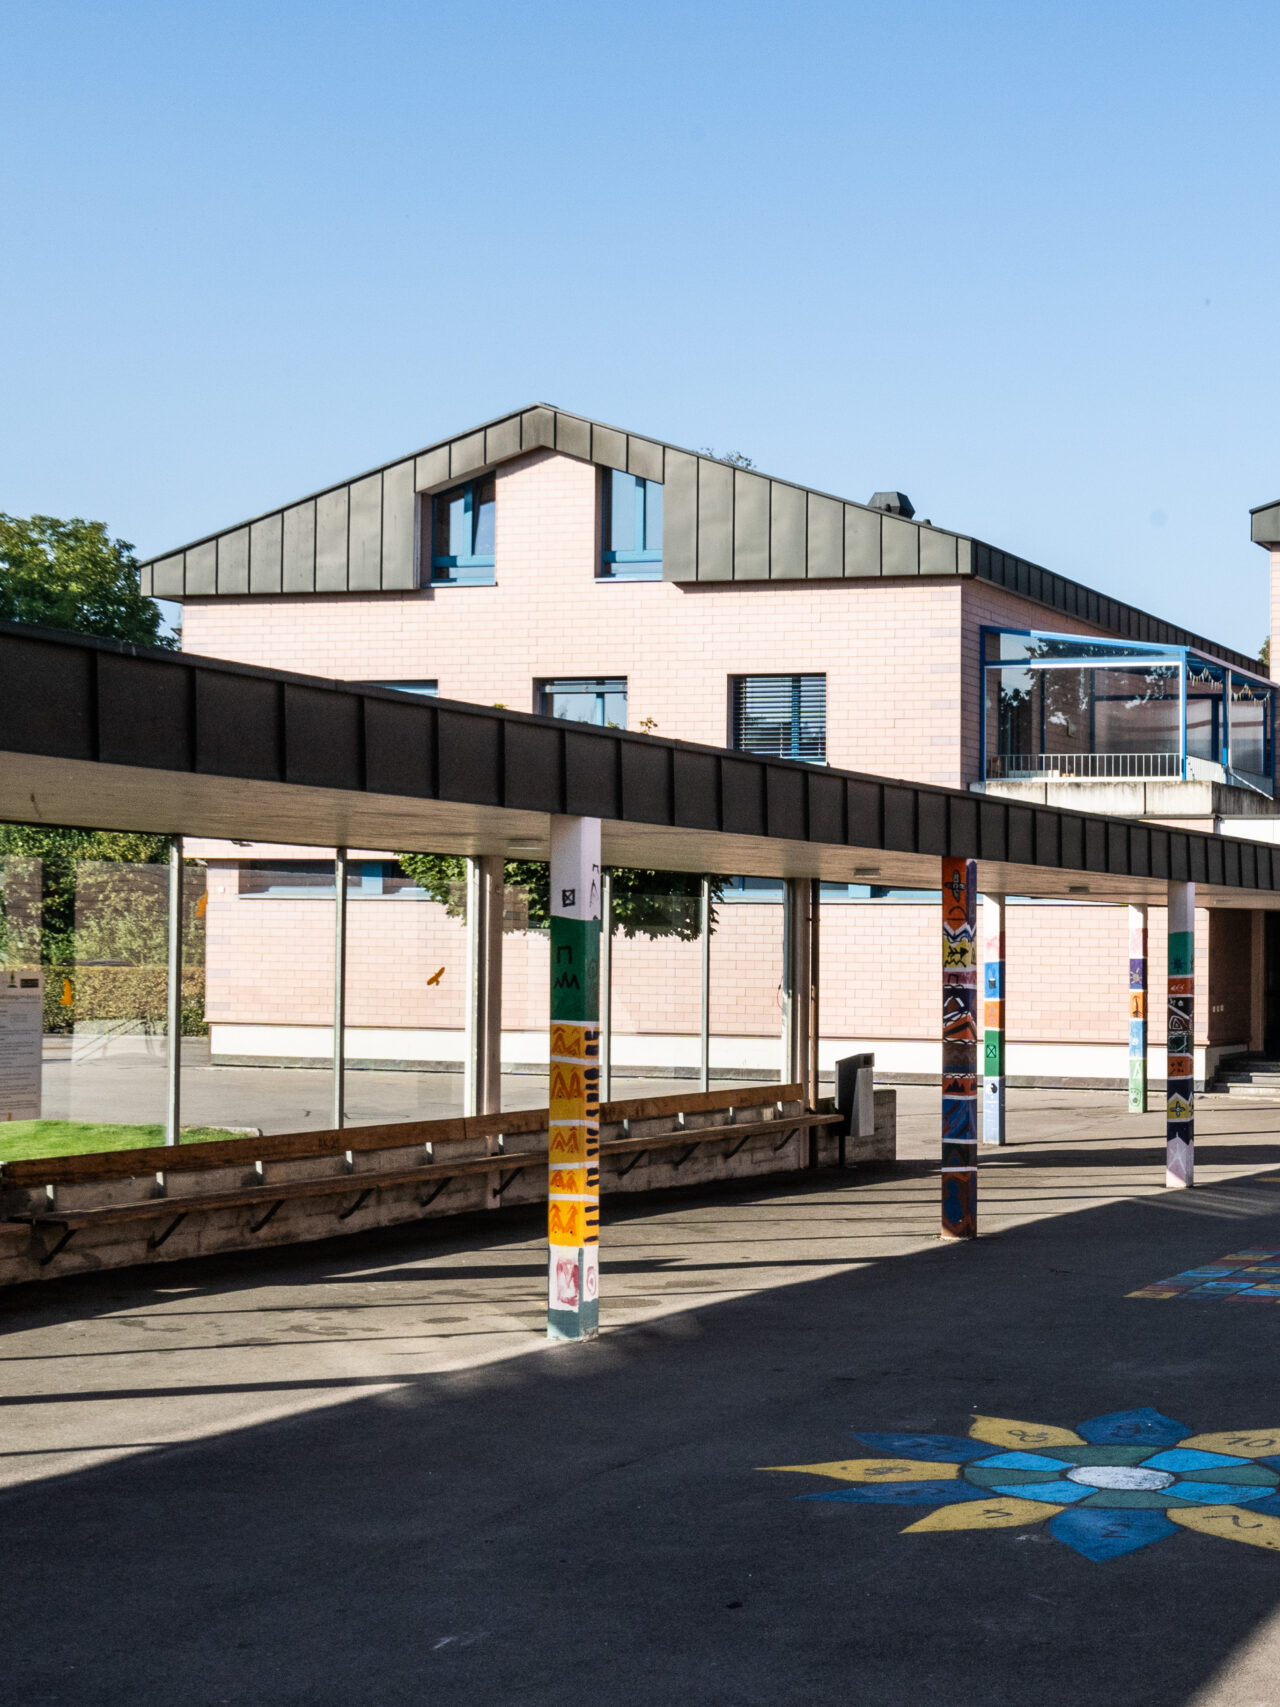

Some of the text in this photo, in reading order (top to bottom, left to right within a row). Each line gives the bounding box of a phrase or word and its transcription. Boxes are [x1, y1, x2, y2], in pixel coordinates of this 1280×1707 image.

[1006, 1428, 1050, 1444] 8
[1221, 1436, 1278, 1448] 10
[975, 1506, 1015, 1520] 4
[1201, 1514, 1265, 1530] 2
